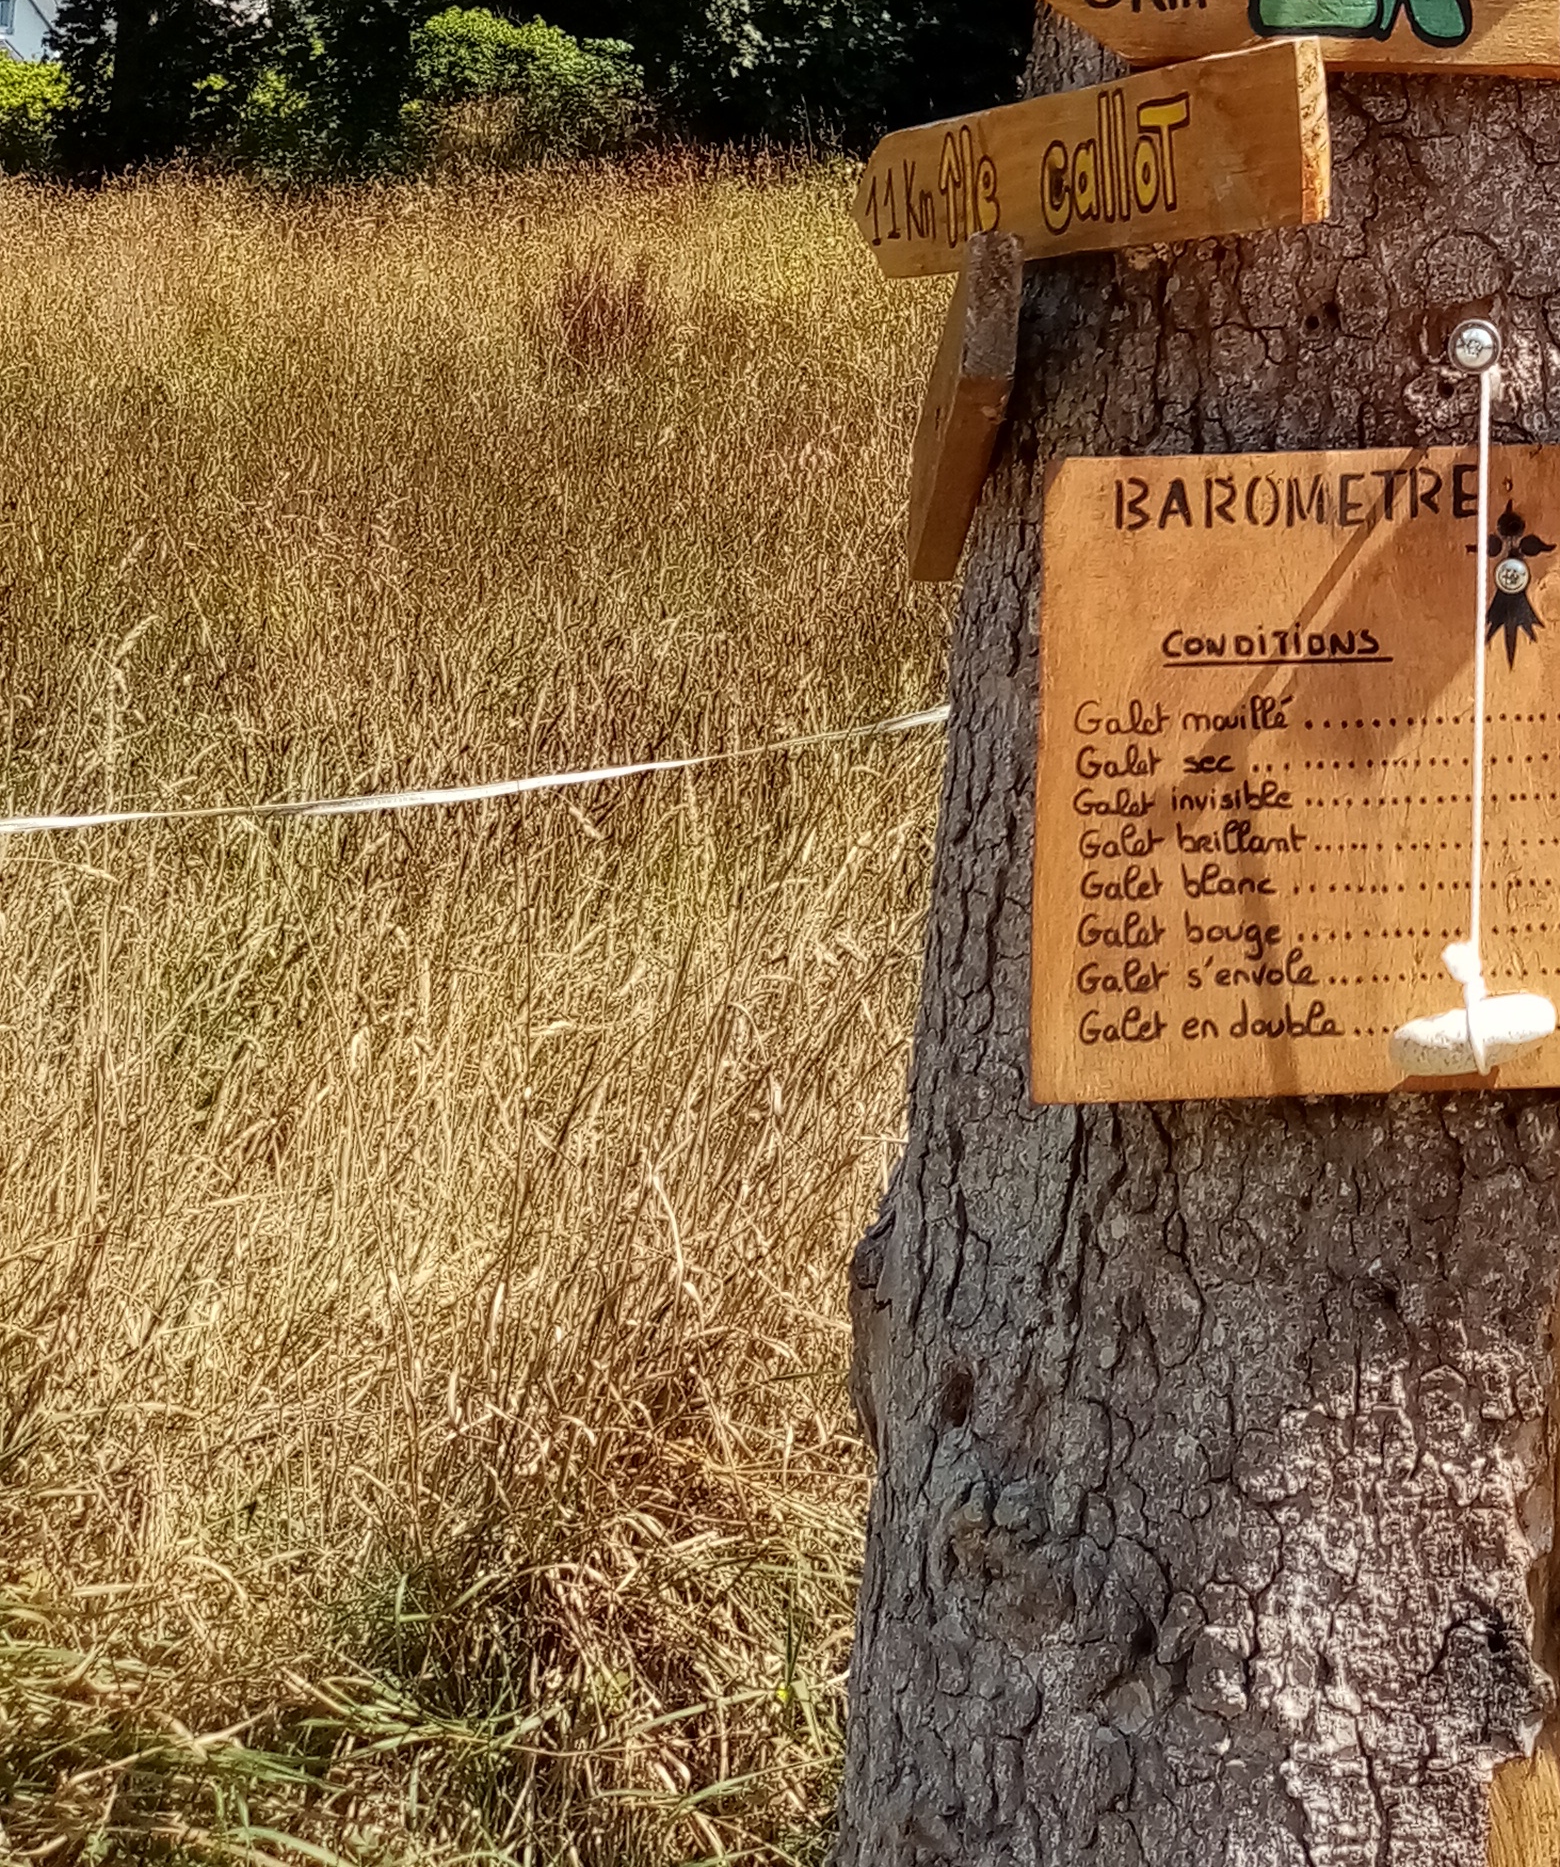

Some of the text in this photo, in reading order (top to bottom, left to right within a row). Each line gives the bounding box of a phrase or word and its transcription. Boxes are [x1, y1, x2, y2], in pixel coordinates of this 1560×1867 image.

[1113, 462, 1480, 532] BAROMETRE
[1073, 698, 1170, 737] Galet
[1182, 694, 1296, 732] mouillé
[1075, 744, 1162, 779] Galet
[1183, 753, 1236, 774] sec
[1072, 787, 1156, 818] Galet
[1171, 779, 1294, 811] invisible
[1079, 822, 1165, 859] Galet
[1176, 819, 1308, 855] brillant
[1079, 863, 1165, 902] Galet
[1181, 862, 1277, 897] blanc
[1076, 910, 1167, 949] Galet
[1184, 909, 1283, 961] bouge
[1076, 957, 1170, 995] Galet
[1187, 947, 1320, 989] s'envole
[1078, 1006, 1168, 1045] Galet
[1181, 1015, 1219, 1040] en
[1228, 999, 1347, 1040] double
